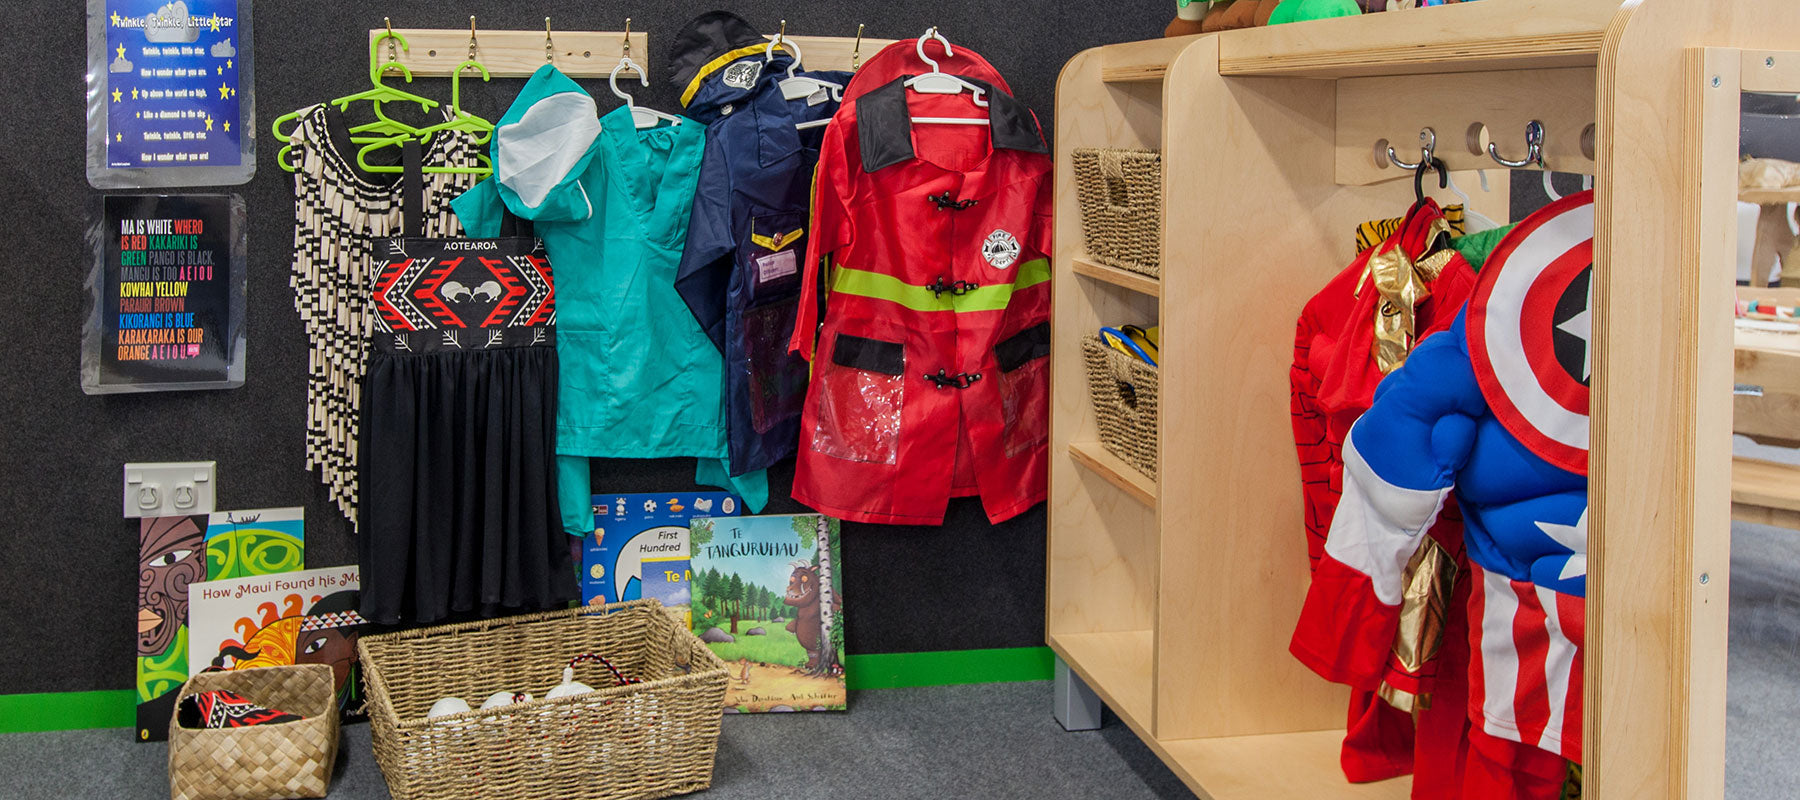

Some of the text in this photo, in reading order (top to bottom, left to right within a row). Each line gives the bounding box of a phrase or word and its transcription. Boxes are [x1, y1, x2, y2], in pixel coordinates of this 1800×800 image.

[116, 16, 233, 30] Twinkle, Twinkle, Little Star
[121, 219, 204, 235] MA IS WHITE WHERO
[121, 235, 199, 250] IS RED KAKARIKI IS
[443, 241, 498, 251] AOTEAROA
[121, 251, 147, 266] GREEN
[148, 251, 176, 266] PANGO
[177, 250, 186, 266] IS
[120, 266, 150, 282] MANGU
[152, 266, 161, 281] IS
[162, 266, 178, 281] TOO
[179, 265, 186, 281] A
[187, 265, 193, 281] E
[199, 265, 205, 281] O
[207, 265, 213, 281] U
[120, 281, 188, 297] KOWHAI YELLOW
[119, 297, 185, 313] PARAURI BROWN
[119, 312, 195, 329] KIKORANGI IS BLUE
[118, 328, 204, 345] KARAKARAKA IS OUR
[117, 345, 150, 361] ORANGE
[151, 344, 158, 360] A
[159, 344, 165, 360] E
[172, 344, 178, 360] O
[658, 531, 678, 540] First
[730, 527, 743, 539] TE
[640, 543, 681, 553] Hundred
[705, 541, 799, 560] TANGURUHAU
[664, 570, 680, 583] Te
[203, 589, 231, 600] How
[235, 582, 272, 599] Maui
[275, 577, 315, 591] Found
[319, 575, 336, 587] his
